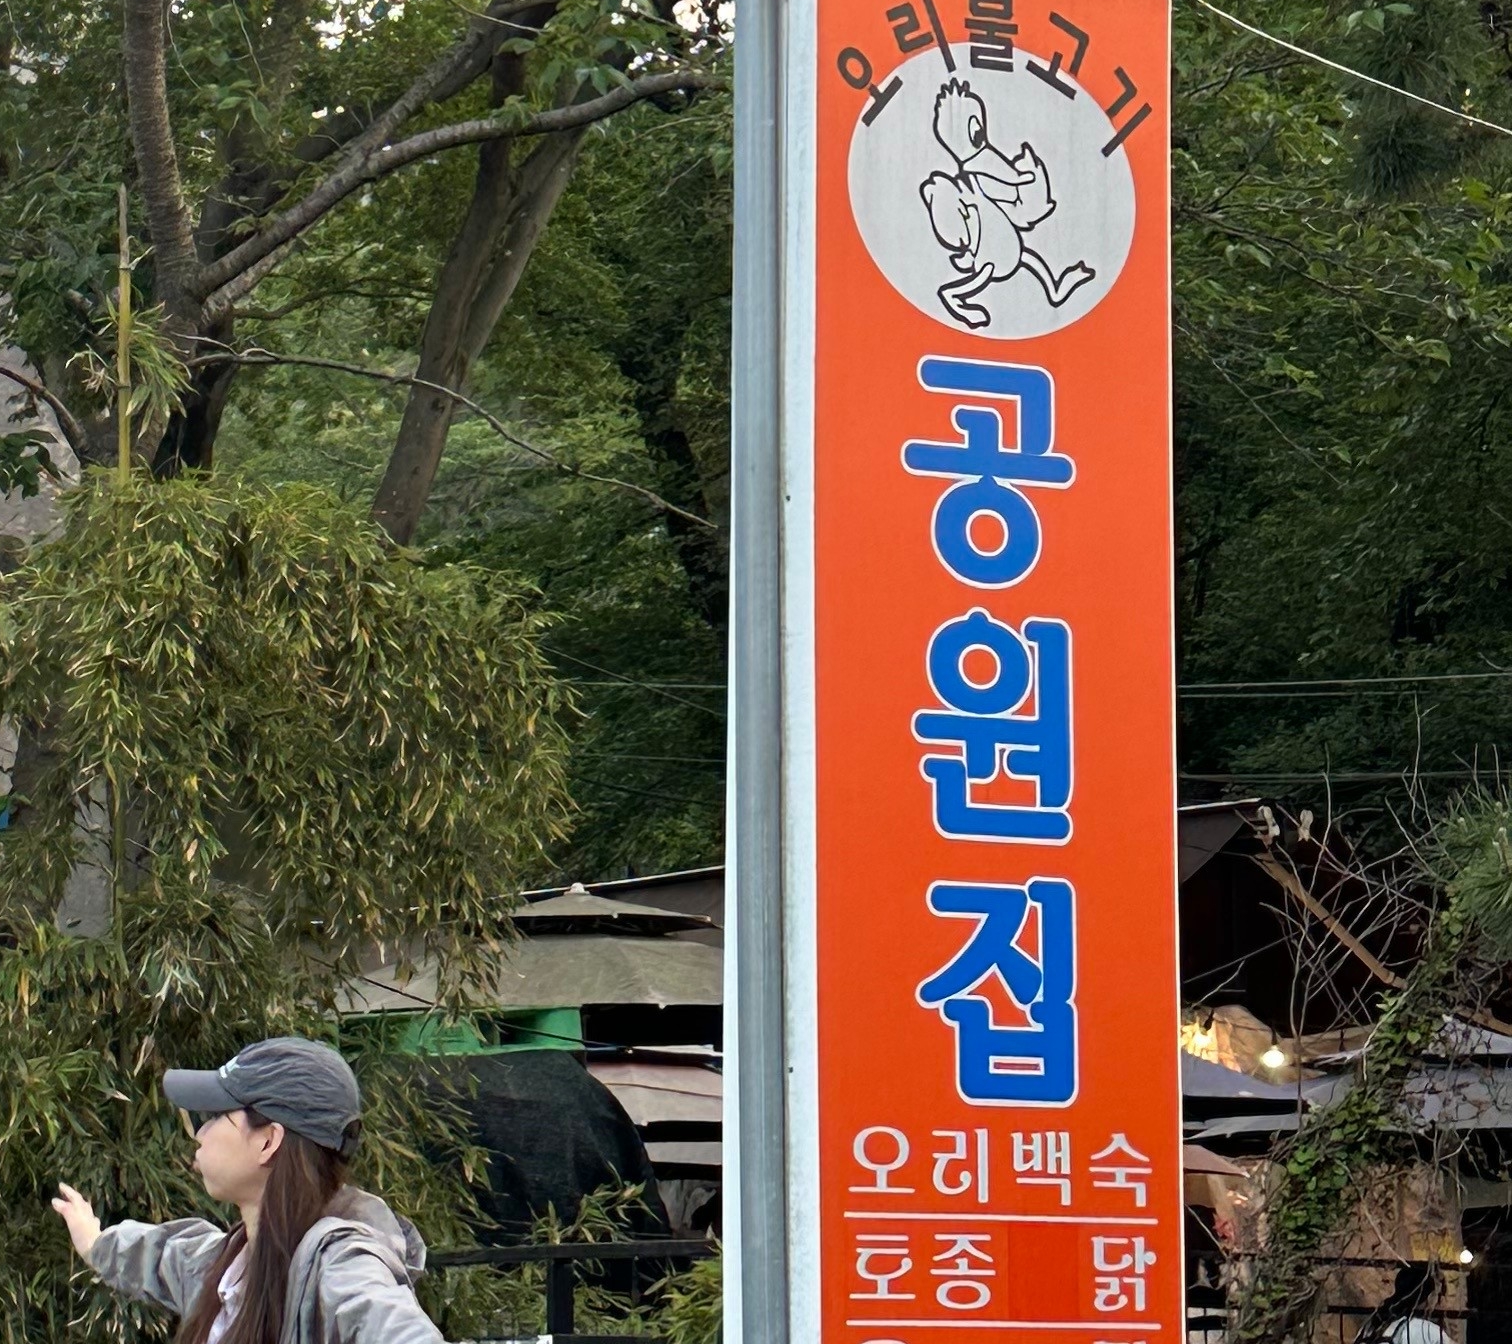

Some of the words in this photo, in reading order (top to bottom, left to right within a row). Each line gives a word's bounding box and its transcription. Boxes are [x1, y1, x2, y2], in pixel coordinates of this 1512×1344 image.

[900, 354, 1079, 1108] 공원집
[849, 1126, 1153, 1208] 오리백숙
[850, 1234, 996, 1310] 토종
[1091, 1236, 1157, 1312] 닭
